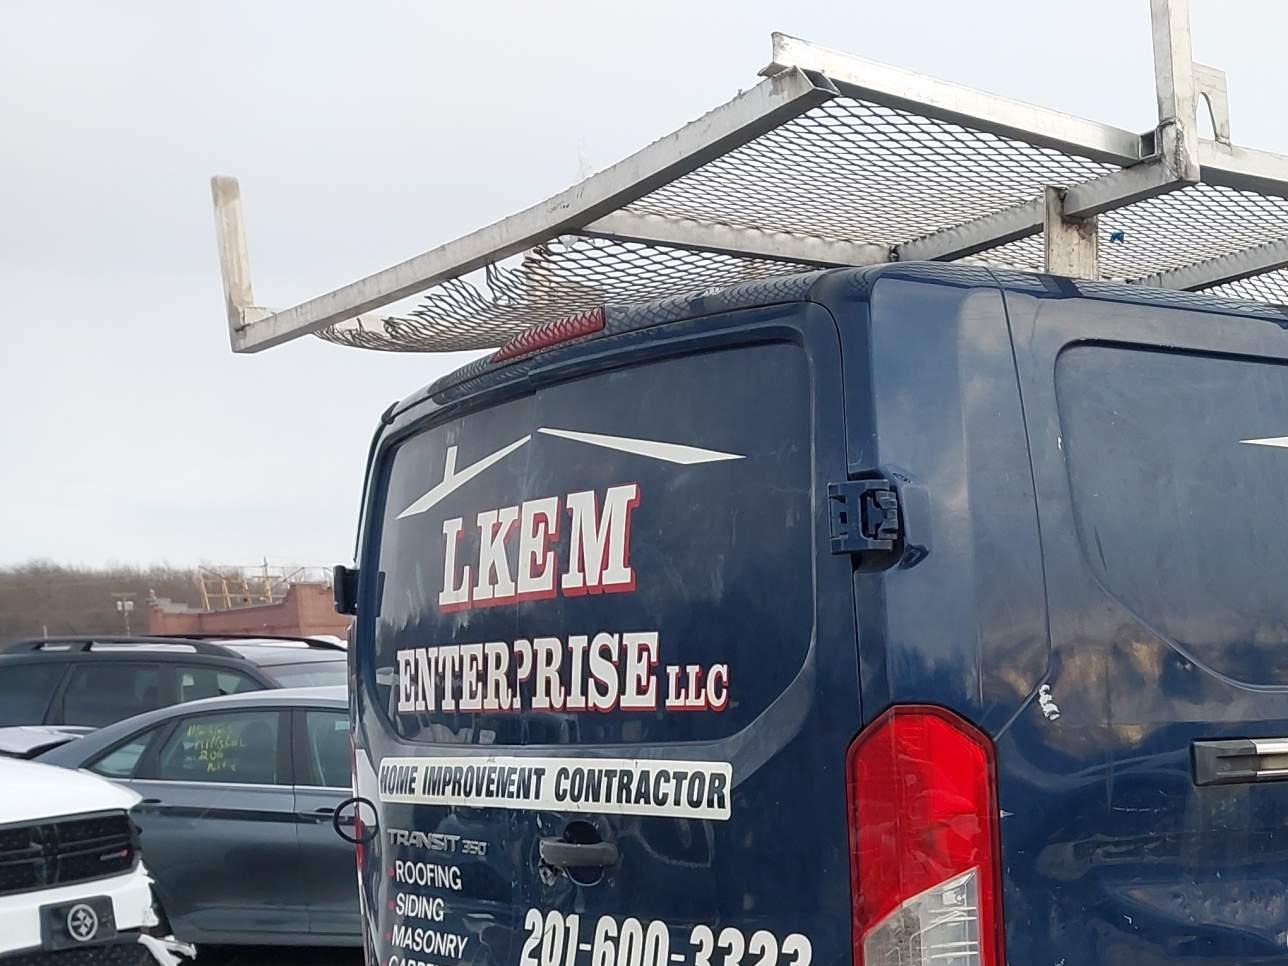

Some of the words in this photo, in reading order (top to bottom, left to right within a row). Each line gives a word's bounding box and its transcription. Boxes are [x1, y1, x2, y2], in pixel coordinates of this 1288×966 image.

[438, 481, 641, 613] LKEM
[396, 631, 661, 714] ENTERPRISE
[664, 663, 731, 713] LLC
[380, 764, 417, 796] HOME
[421, 764, 546, 801] IMPROVEMENT
[554, 767, 728, 809] CONTRACTOR
[387, 828, 461, 852] TRANSIT
[461, 839, 487, 856] 350
[395, 860, 463, 891] ROOFING
[395, 893, 445, 922] SIDING
[391, 924, 469, 960] MASONRY
